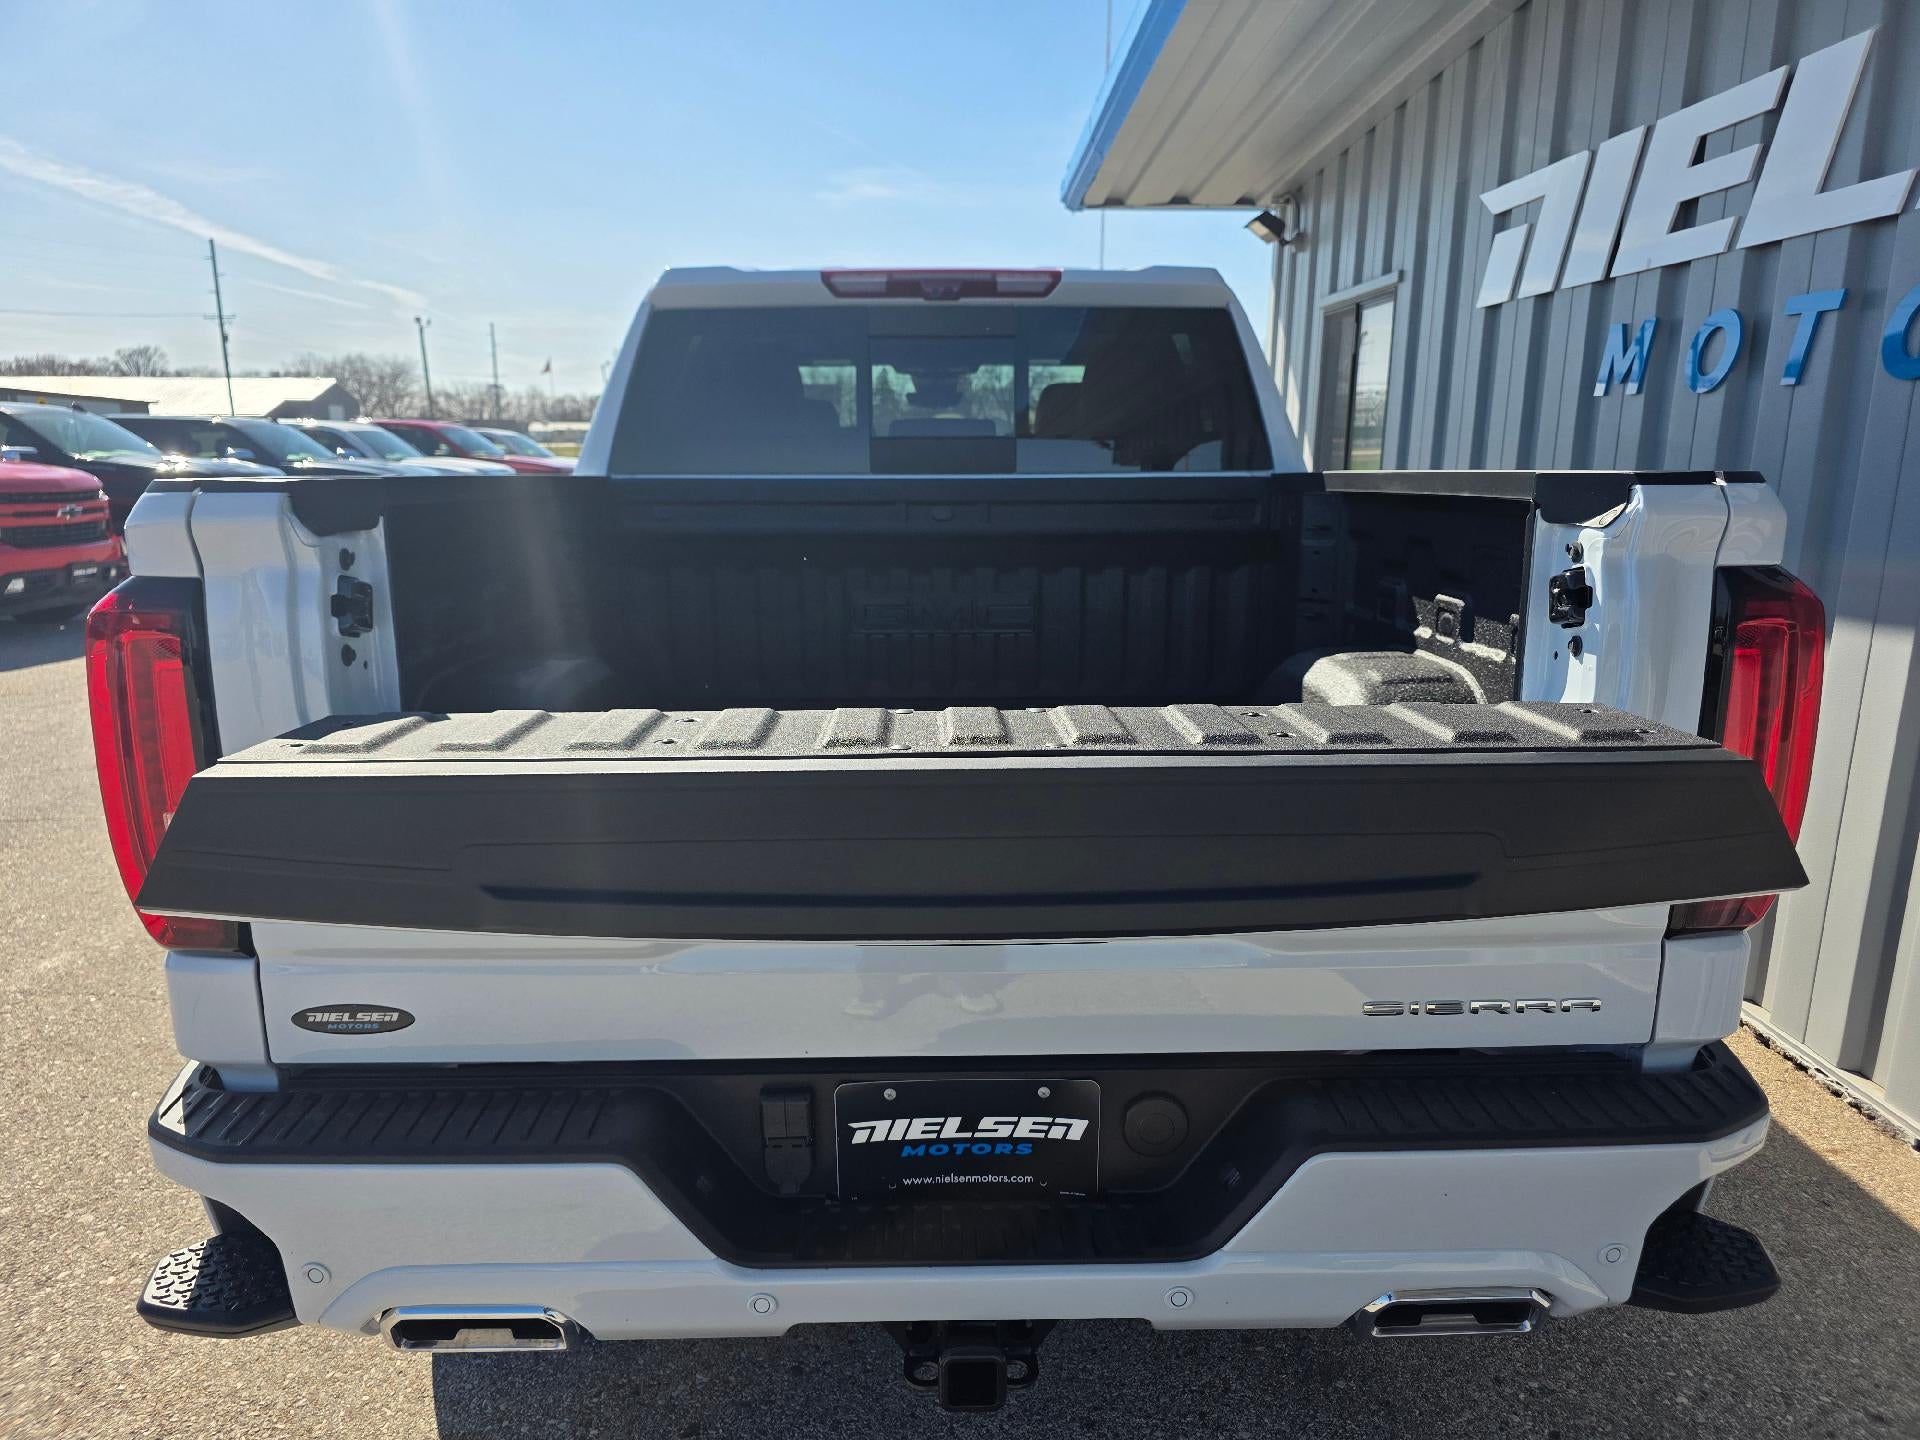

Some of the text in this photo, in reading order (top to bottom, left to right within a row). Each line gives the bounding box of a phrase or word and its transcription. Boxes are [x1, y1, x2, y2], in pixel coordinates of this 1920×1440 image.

[1476, 25, 1920, 310] NIEL
[851, 600, 1034, 635] GMC
[1362, 997, 1602, 1016] SIERRA
[305, 1012, 400, 1022] NIELSEN
[847, 1116, 1089, 1144] NIELSEN
[901, 1143, 1033, 1157] MOTORS
[902, 1173, 1034, 1186] www.nielsenmotors.com
